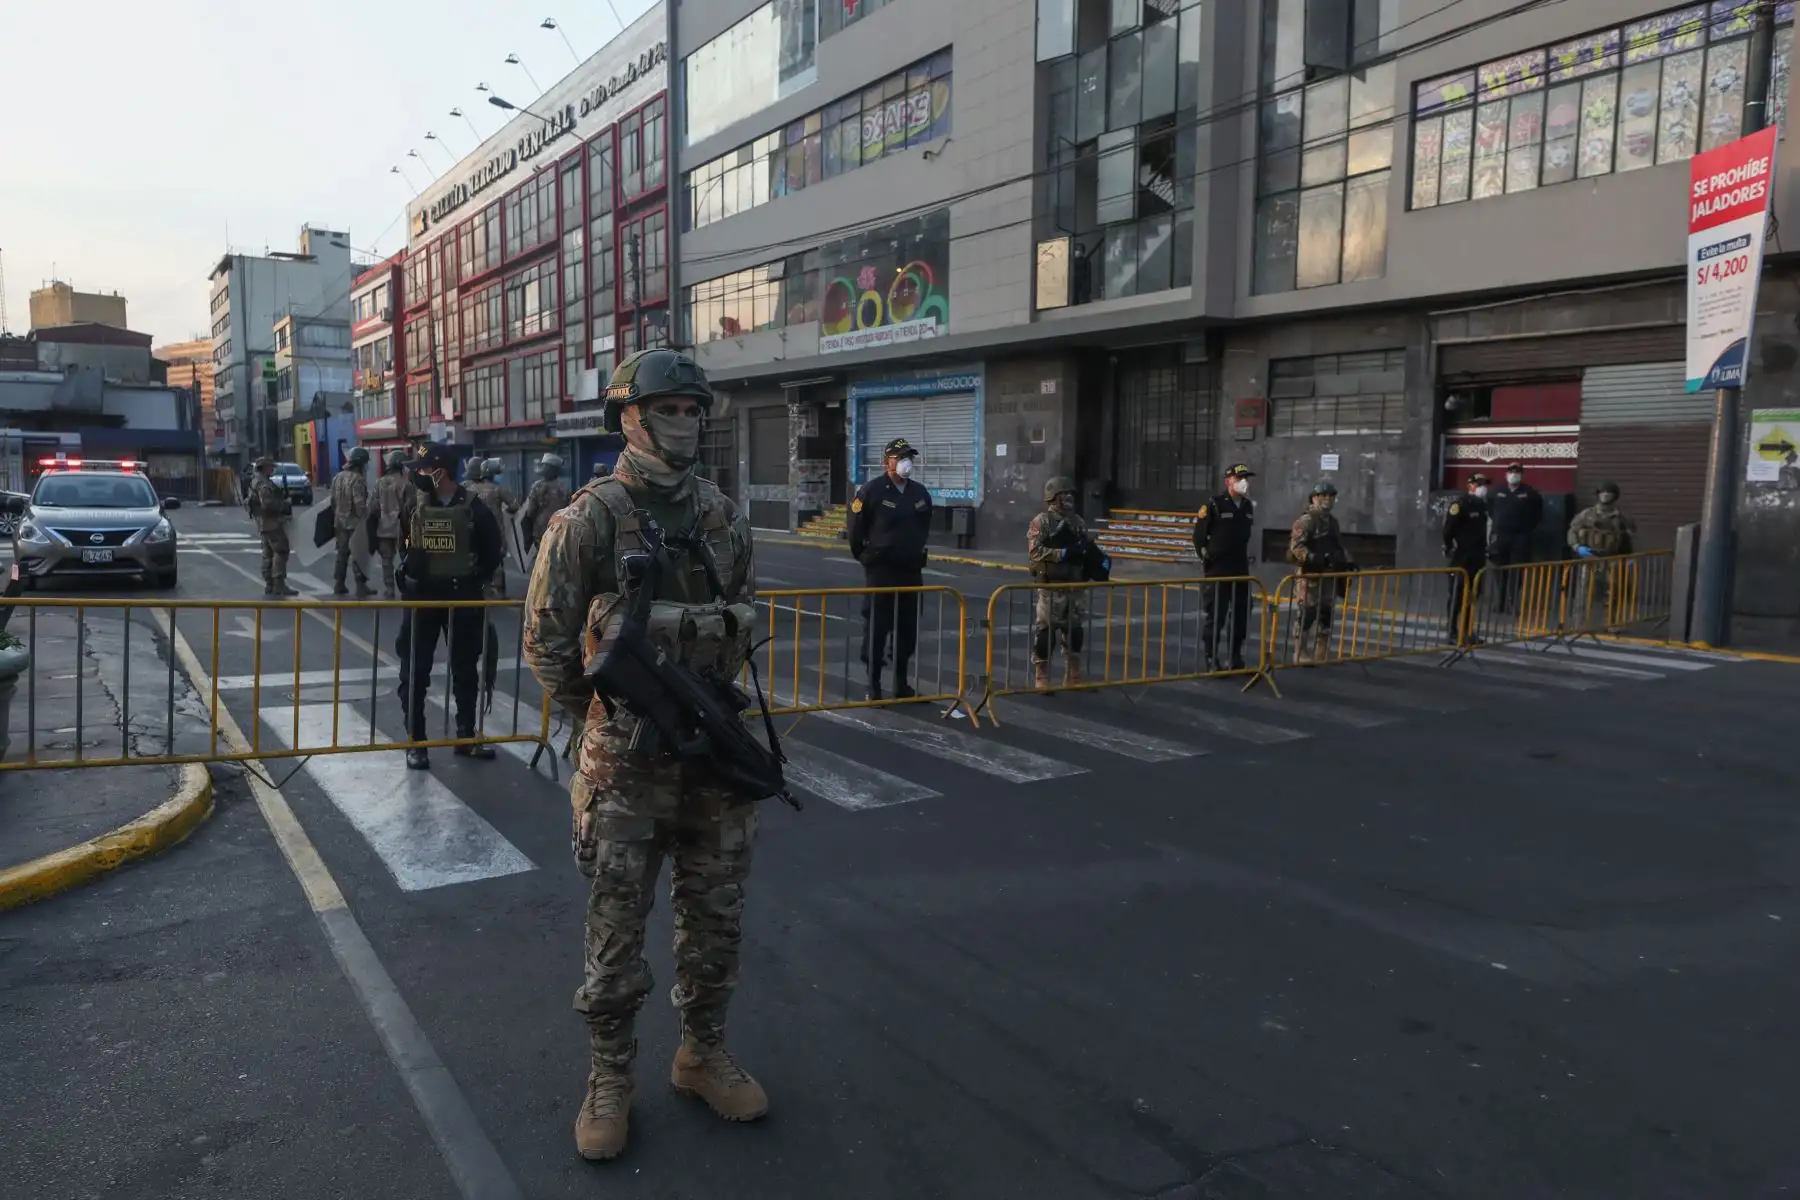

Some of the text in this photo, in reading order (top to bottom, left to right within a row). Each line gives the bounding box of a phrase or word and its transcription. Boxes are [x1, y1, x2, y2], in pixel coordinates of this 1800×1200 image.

[468, 148, 515, 197] MERCADO
[518, 103, 574, 160] CENTRAL
[1693, 156, 1769, 198] SE PROHÍBE
[1692, 179, 1766, 224] JALADORES
[1701, 237, 1748, 259] Evite la multa
[1712, 255, 1748, 283] 4,200
[937, 376, 975, 390] NEGOCIO
[422, 537, 454, 550] POLICIA
